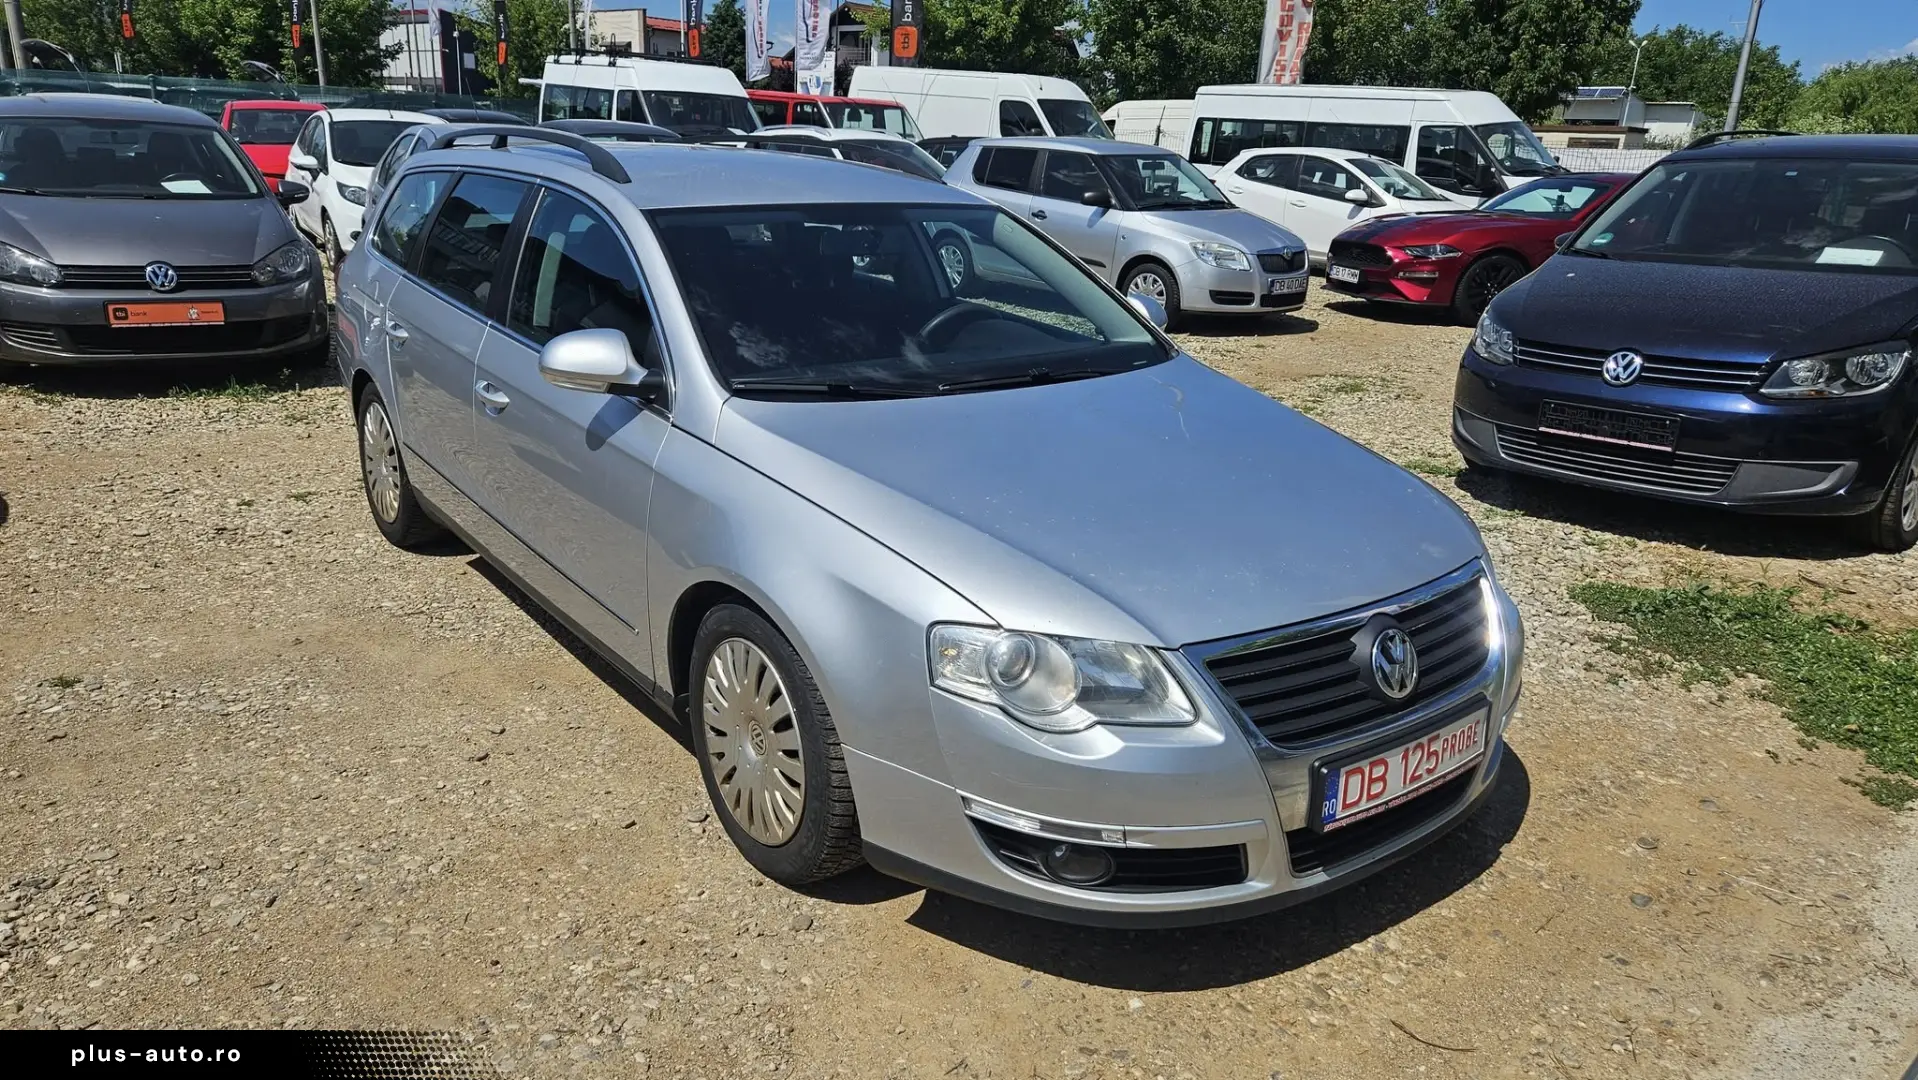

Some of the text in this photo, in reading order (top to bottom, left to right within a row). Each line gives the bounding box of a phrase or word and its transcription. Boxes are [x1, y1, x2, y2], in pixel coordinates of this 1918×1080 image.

[901, 32, 910, 49] tbi
[1275, 280, 1285, 291] DB
[1602, 351, 1641, 384] VW
[1372, 629, 1418, 698] VW
[1321, 798, 1337, 818] RO
[1341, 757, 1390, 812] DB
[1400, 733, 1440, 789] 125
[1440, 719, 1481, 764] PROBE
